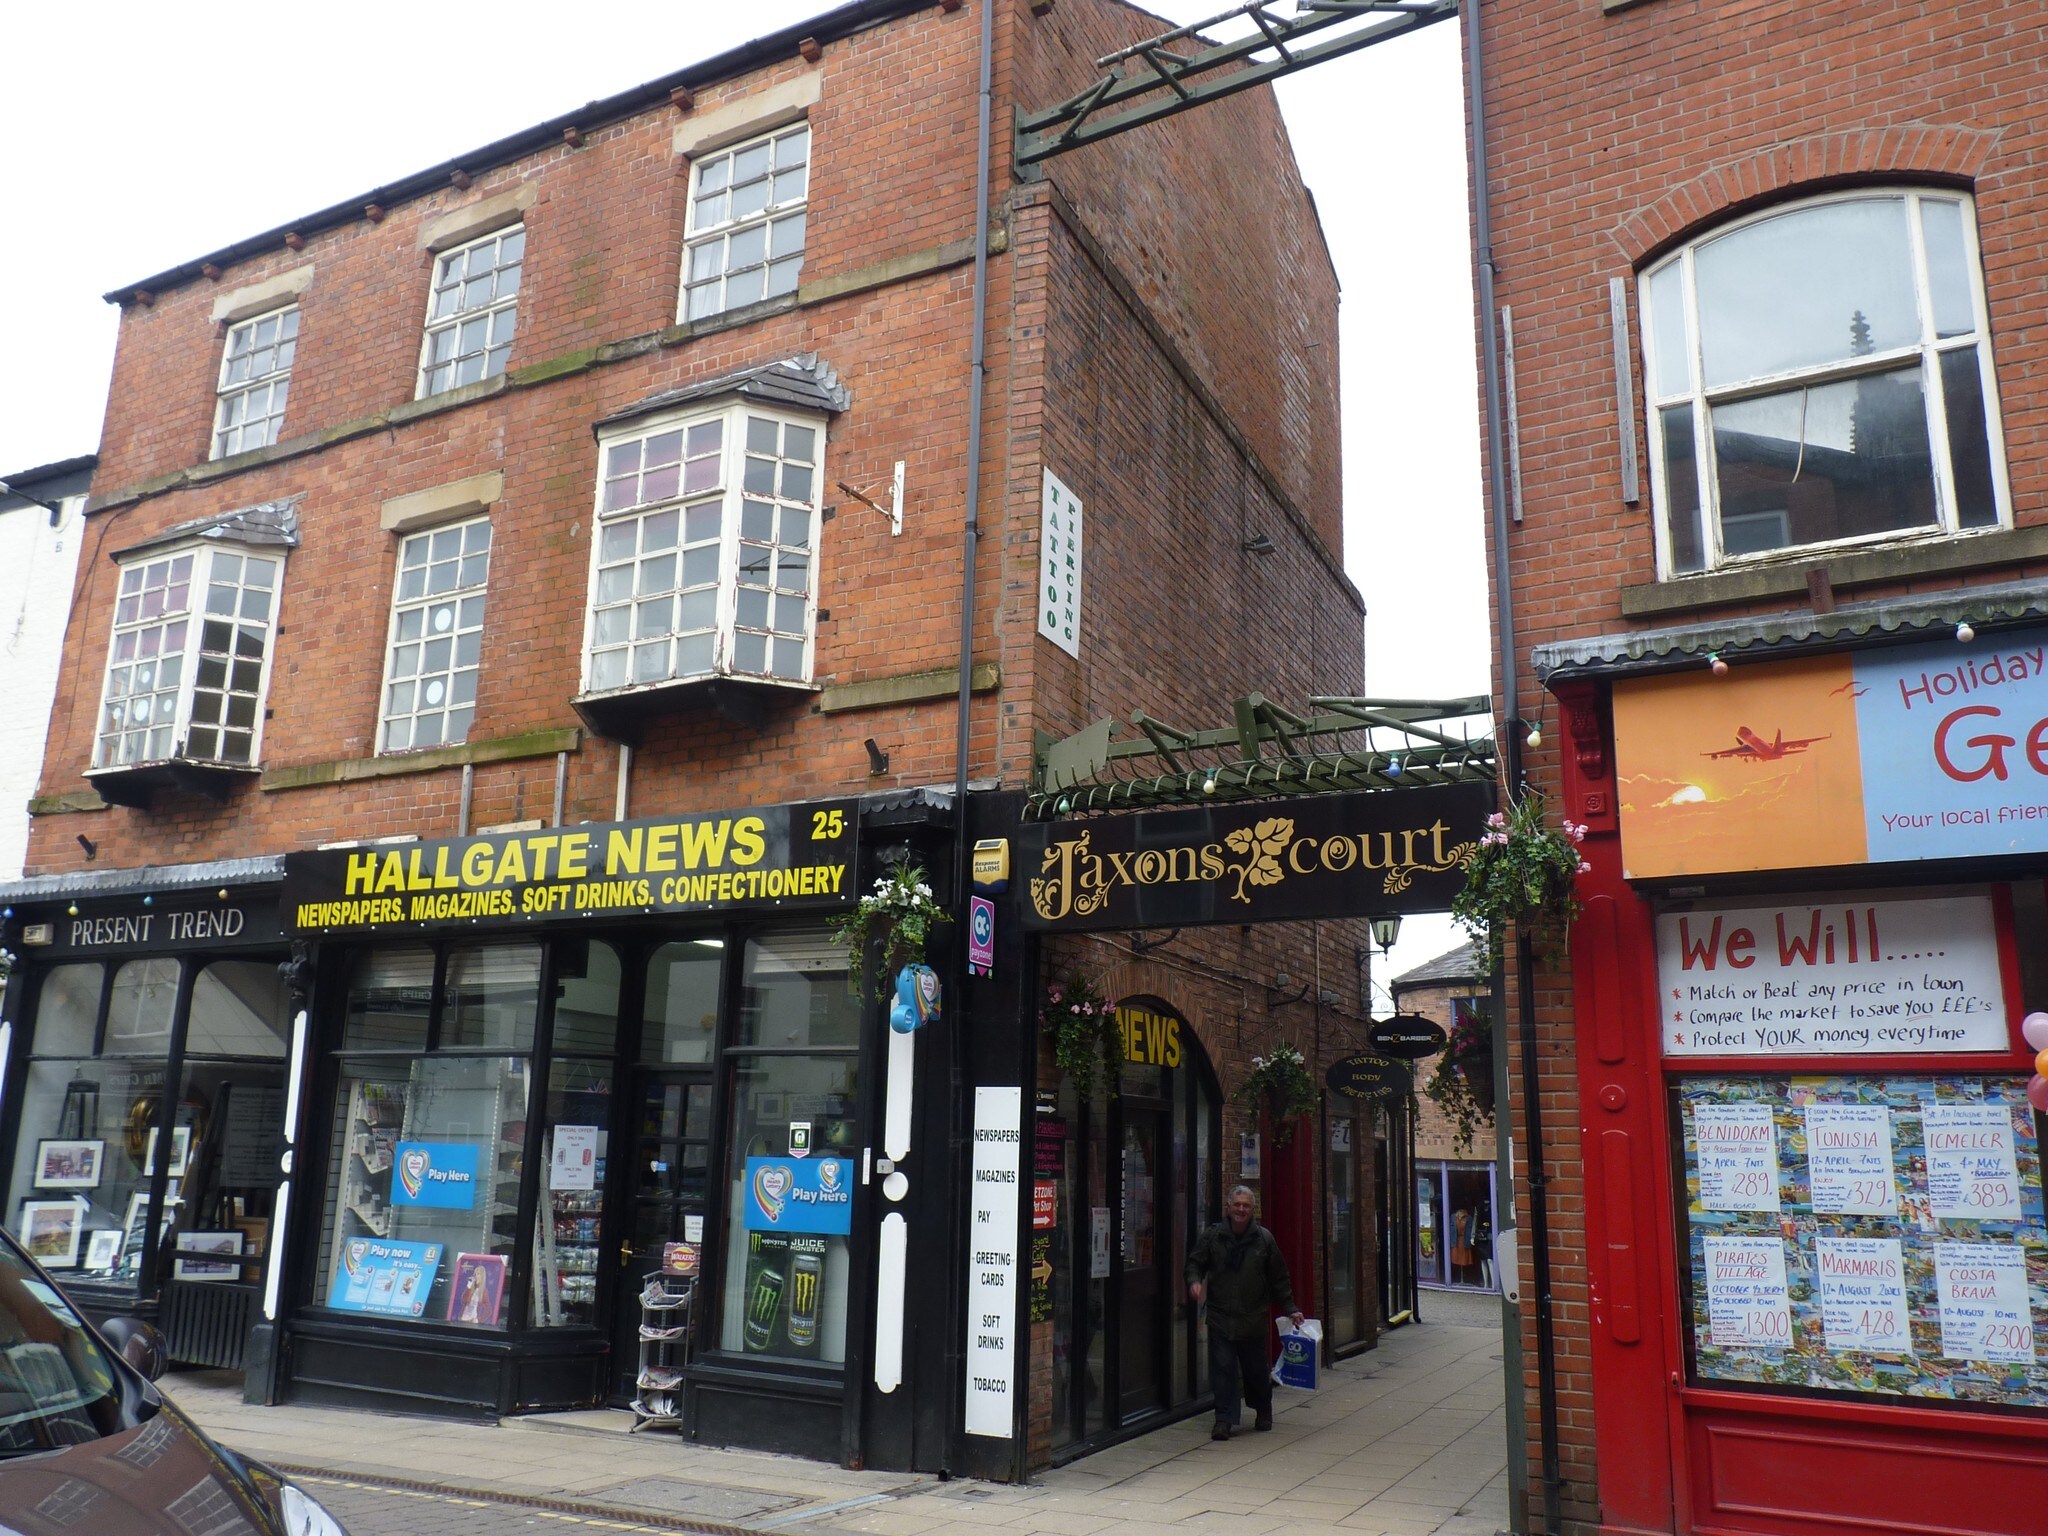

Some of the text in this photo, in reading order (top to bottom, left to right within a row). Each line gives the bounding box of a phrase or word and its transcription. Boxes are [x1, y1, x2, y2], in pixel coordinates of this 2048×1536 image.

[1046, 485, 1060, 629] TATTOO
[1064, 500, 1076, 642] PIERCING
[1899, 647, 2044, 710] Holiday
[1882, 813, 1933, 832] Your
[1941, 808, 1990, 826] local
[345, 810, 843, 895] HALLGATE NEWS 25
[975, 865, 1000, 873] ALARMS
[1030, 818, 1465, 921] Jaxons court
[297, 864, 846, 928] NEWSPAPERS. MAGAZINES. SOFT DRINKS. CONFECTIONERY
[70, 914, 154, 946] PRESENT
[168, 908, 244, 940] TREND
[1679, 915, 1756, 971] We
[971, 946, 992, 961] payzone
[1742, 988, 1758, 999] or
[1808, 985, 1835, 1001] any
[1843, 981, 1885, 998] price
[1898, 978, 1914, 991] in
[1923, 974, 1963, 992] town
[1690, 1007, 1743, 1026] Compare
[1752, 1004, 1773, 1021] the
[1780, 1005, 1840, 1020] market
[1904, 1000, 1933, 1016] YOU
[1115, 1006, 1180, 1068] NEWS
[1693, 1030, 1746, 1047] Protect
[1757, 1027, 1805, 1048] YOUR
[1877, 1025, 1965, 1046] everytime
[1346, 1057, 1389, 1067] TATTOO
[1352, 1073, 1381, 1081] BODY
[1341, 1085, 1393, 1098] PIERCING
[974, 1129, 1020, 1142] NEWSPAPERS
[1697, 1125, 1770, 1141] BENIDORM
[1809, 1126, 1878, 1147] TUNISIA
[1930, 1132, 2004, 1149] ICMELER
[1714, 1158, 1737, 1169] APRIL
[1825, 1156, 1852, 1165] APRIL
[1977, 1158, 2001, 1170] MAY
[428, 1168, 470, 1184] Play Here
[975, 1169, 1016, 1183] MAGAZINES
[792, 1187, 817, 1204] Play
[1040, 1200, 1052, 1212] Shop
[977, 1210, 991, 1223] PAY
[761, 1238, 788, 1247] MONSTER
[789, 1245, 826, 1253] MONSTER
[790, 1238, 825, 1248] JUICE
[371, 1244, 437, 1259] Play now £1
[671, 1253, 695, 1261] WALKERS
[975, 1251, 1011, 1266] GREETING
[1715, 1250, 1768, 1265] PIRATES
[1716, 1266, 1770, 1279] VILLAGE
[1822, 1252, 1897, 1278] MARMARIS
[981, 1272, 1004, 1286] CARDS
[1949, 1269, 1996, 1281] COSTA
[1712, 1285, 1750, 1294] OCTOBER
[1839, 1283, 1872, 1296] AUGUST
[1951, 1284, 1996, 1299] BRAVA
[1956, 1308, 1984, 1317] AUGUST
[982, 1314, 1001, 1329] SOFT
[977, 1335, 1004, 1350] DRINKS
[1288, 1341, 1302, 1352] GO
[973, 1377, 1006, 1393] TOBACCO
